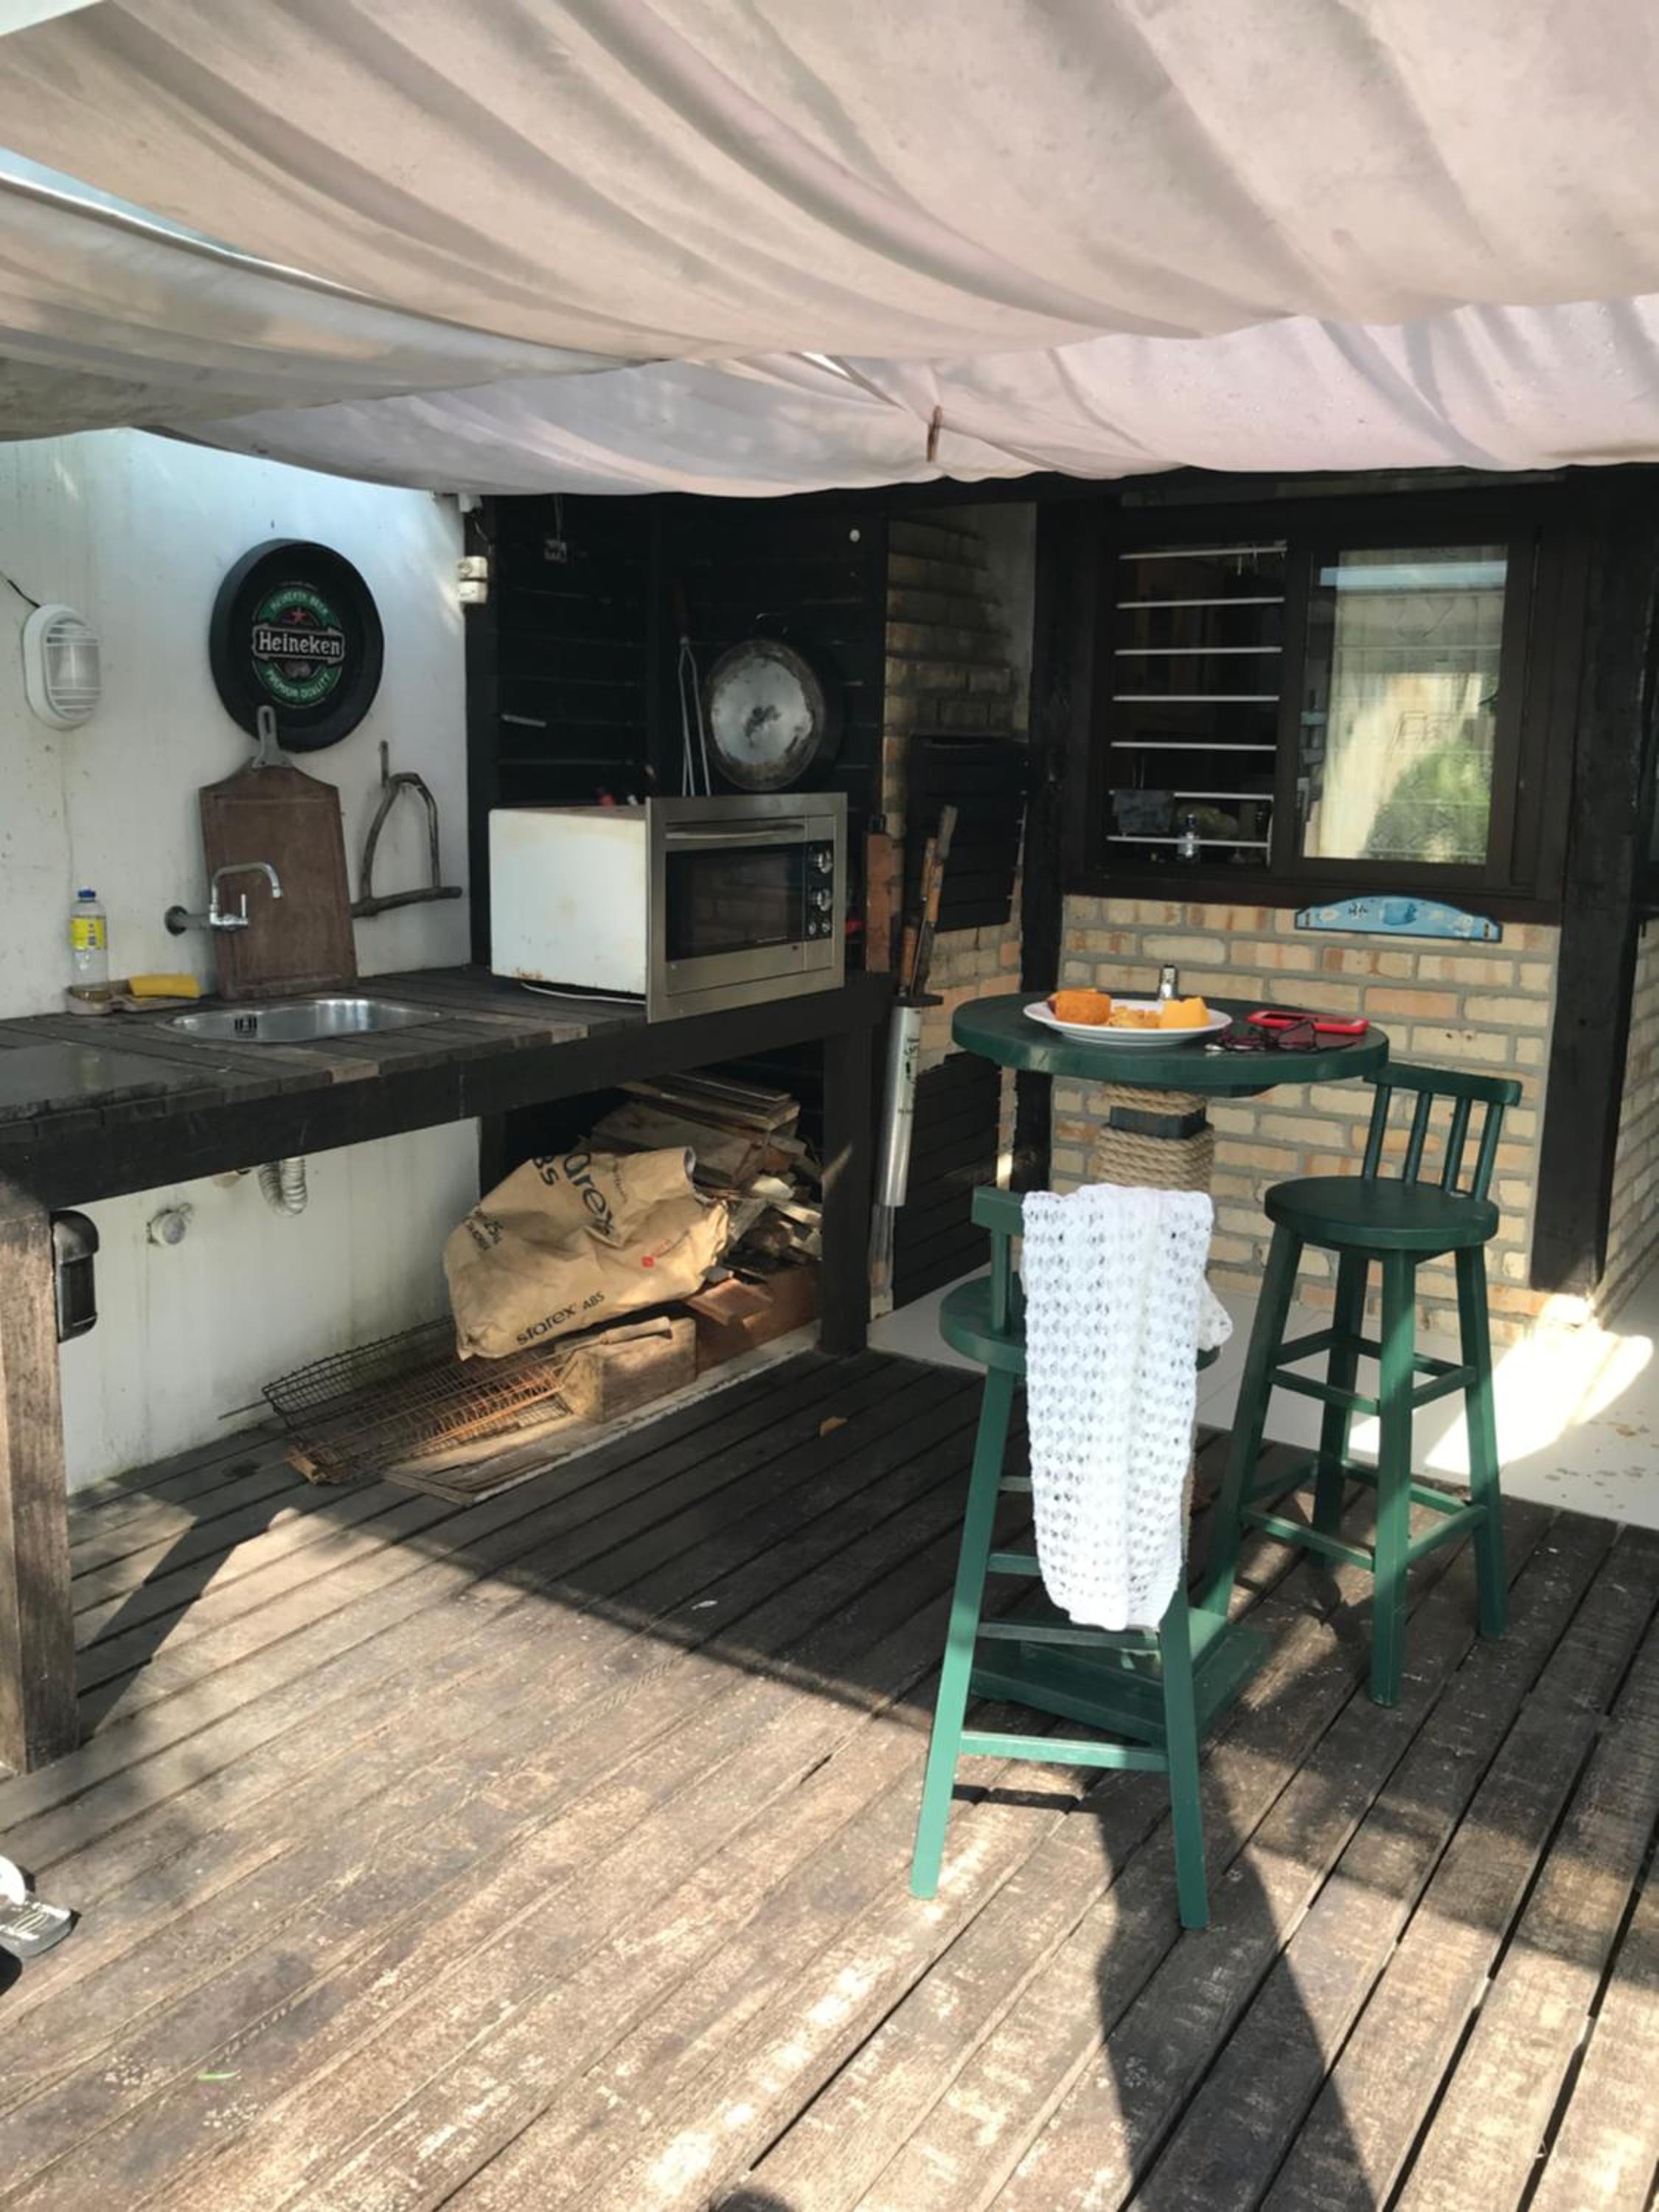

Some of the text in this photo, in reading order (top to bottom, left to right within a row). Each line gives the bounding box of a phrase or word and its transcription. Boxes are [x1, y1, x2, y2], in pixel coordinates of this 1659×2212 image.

[259, 631, 340, 655] Heineken
[517, 1290, 605, 1345] starex ABS
